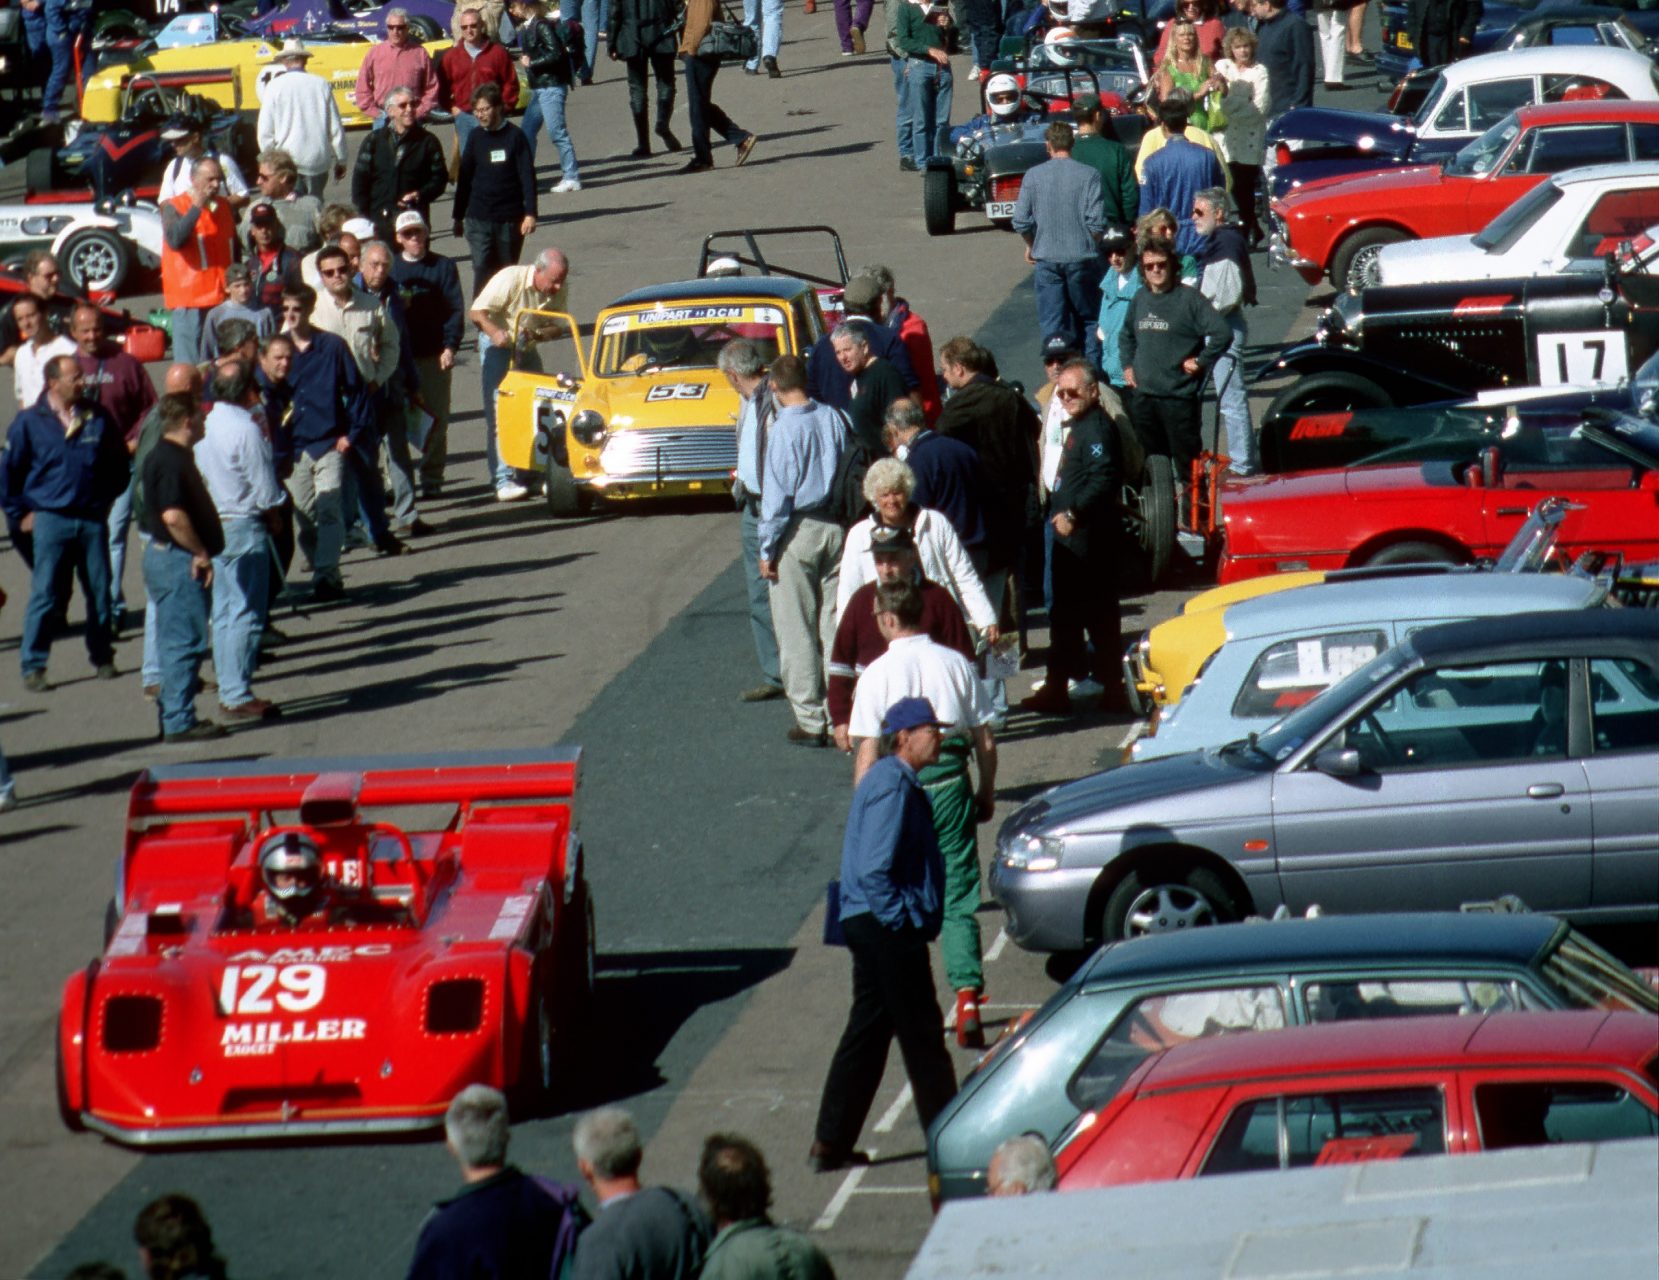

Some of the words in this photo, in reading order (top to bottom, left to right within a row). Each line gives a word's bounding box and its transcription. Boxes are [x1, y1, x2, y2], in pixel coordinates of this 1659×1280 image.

[991, 203, 1016, 216] P12
[641, 309, 692, 323] UNIPART
[706, 308, 740, 319] DCM
[1557, 339, 1606, 384] 17
[650, 384, 701, 399] 53
[227, 943, 392, 963] AMEC
[219, 963, 328, 1016] 129
[220, 1018, 367, 1046] MILLER
